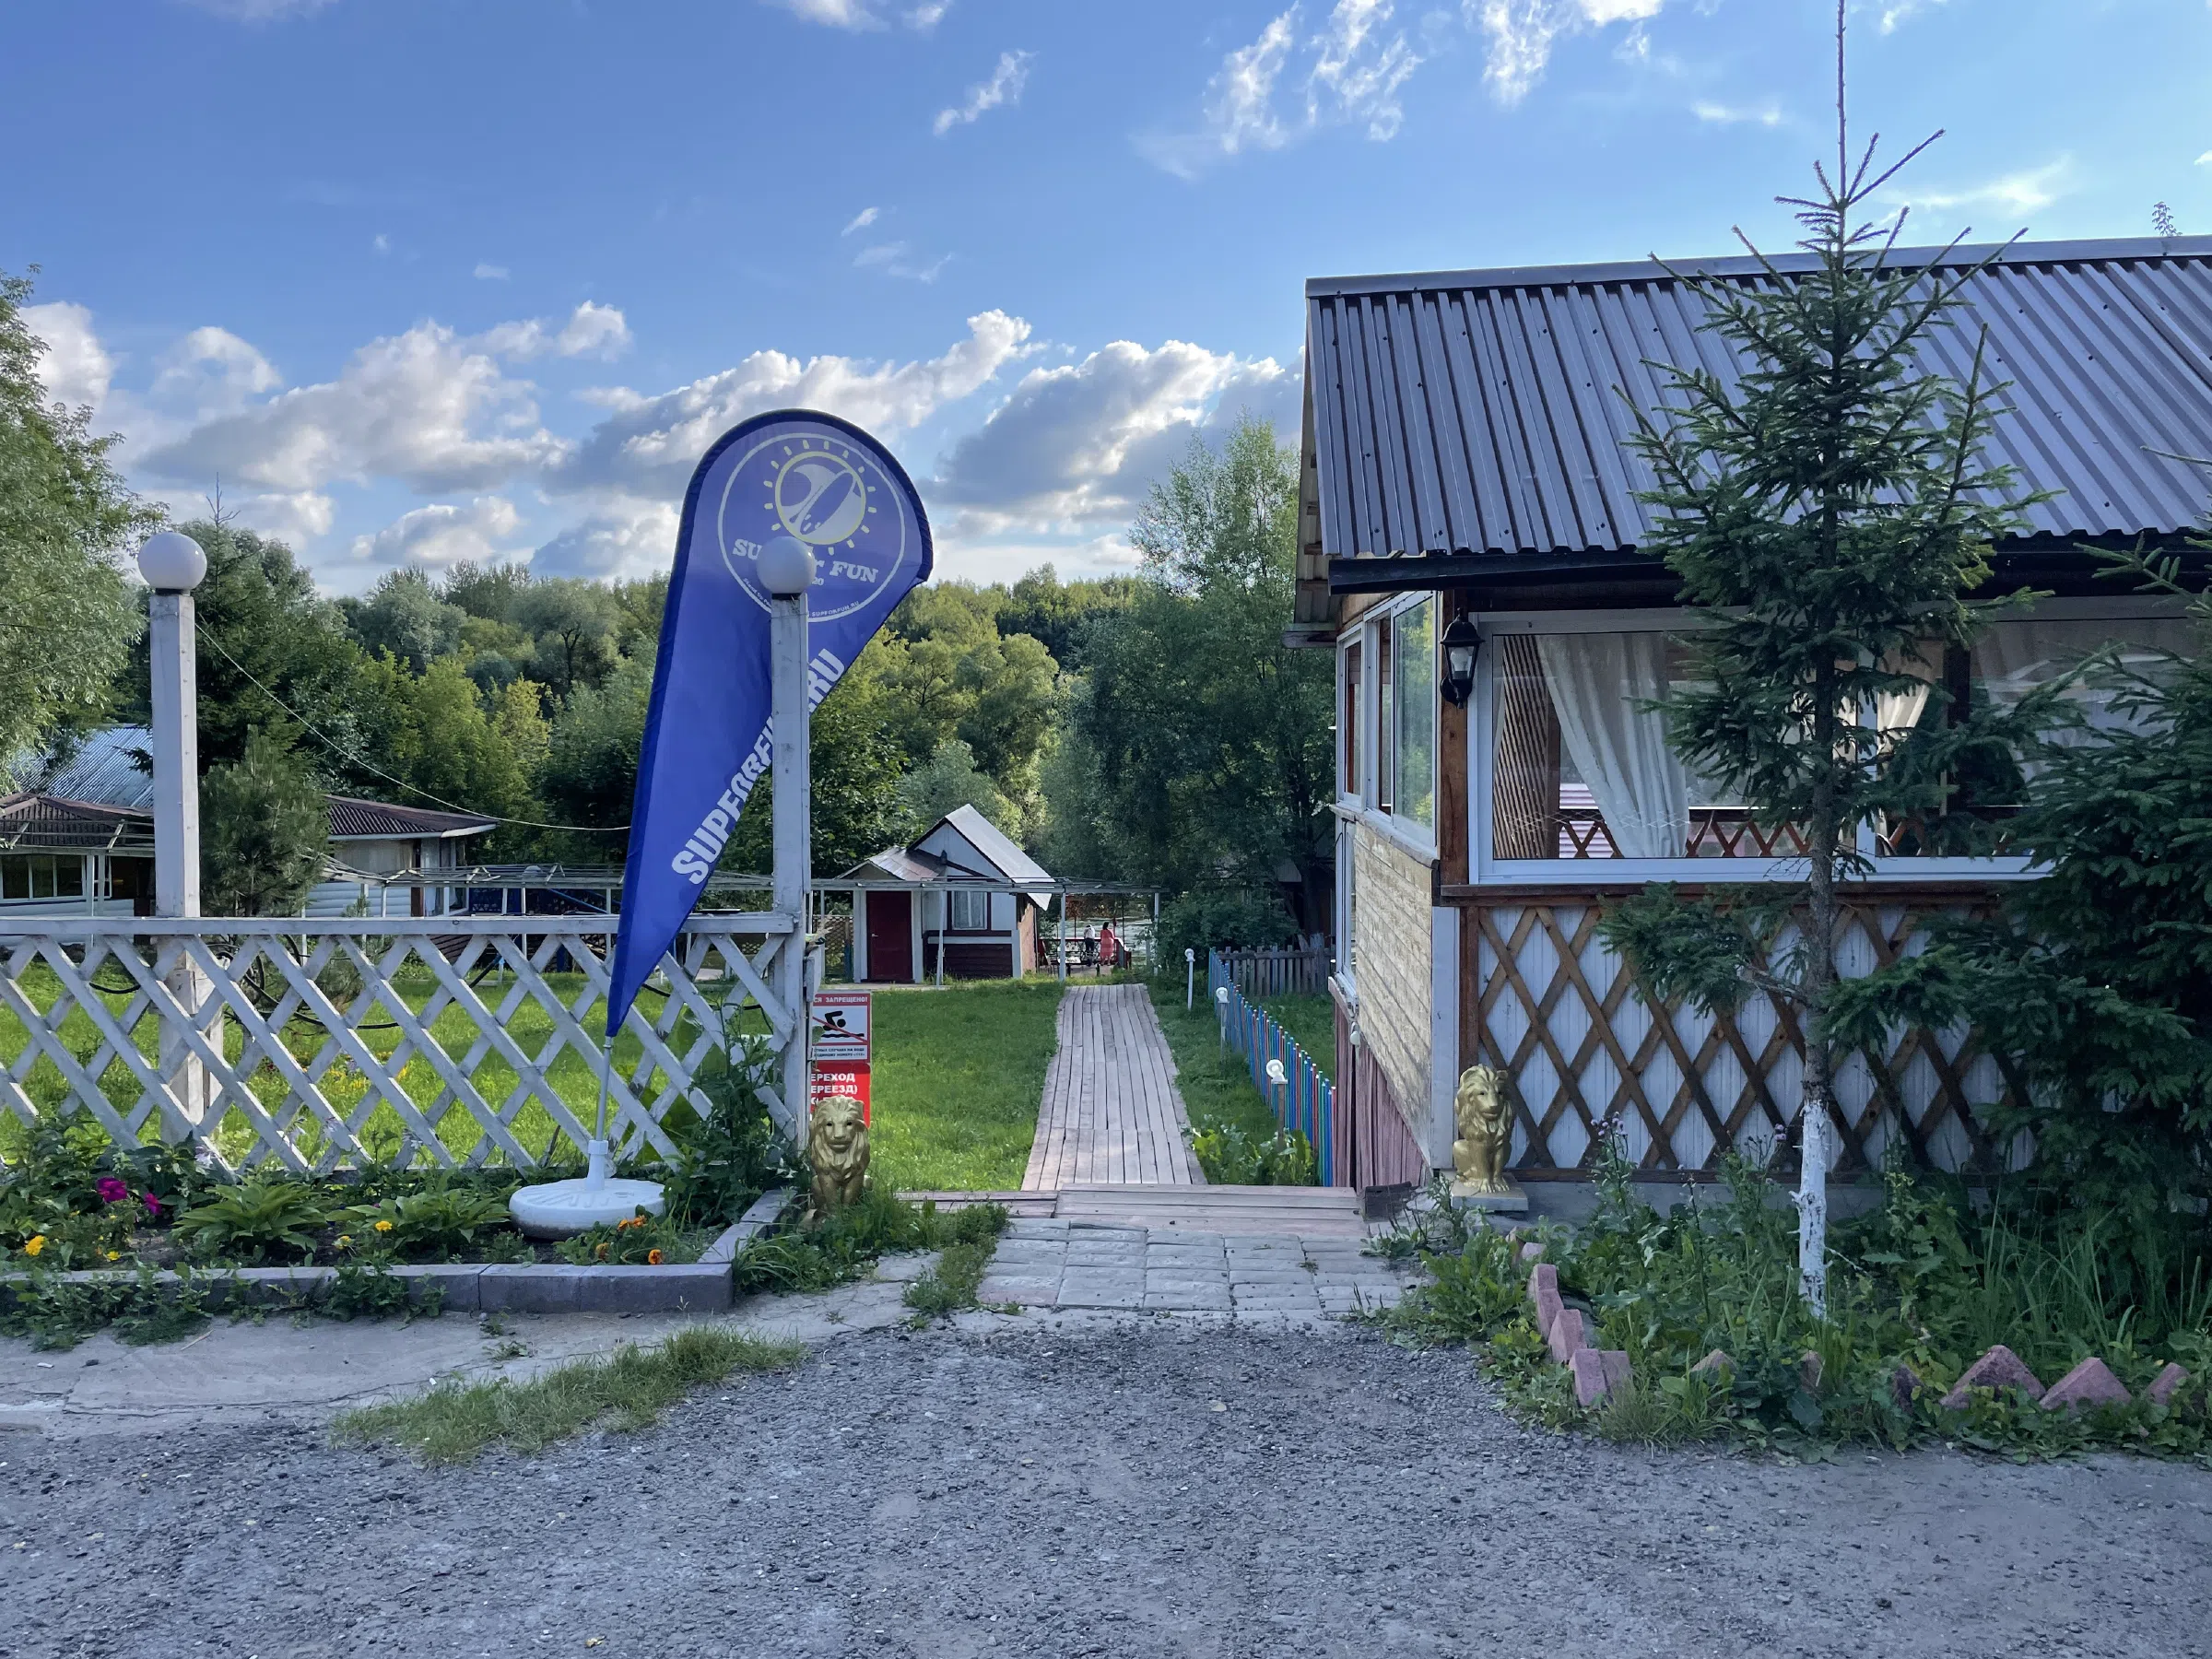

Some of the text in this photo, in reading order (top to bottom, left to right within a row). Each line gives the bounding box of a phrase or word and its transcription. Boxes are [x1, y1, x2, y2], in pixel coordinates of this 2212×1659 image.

[732, 538, 879, 583] SU FUN
[811, 577, 825, 586] 20
[811, 1073, 855, 1082] ЕРЕХОД
[811, 1084, 858, 1094] ЕРЕЕЗД)
